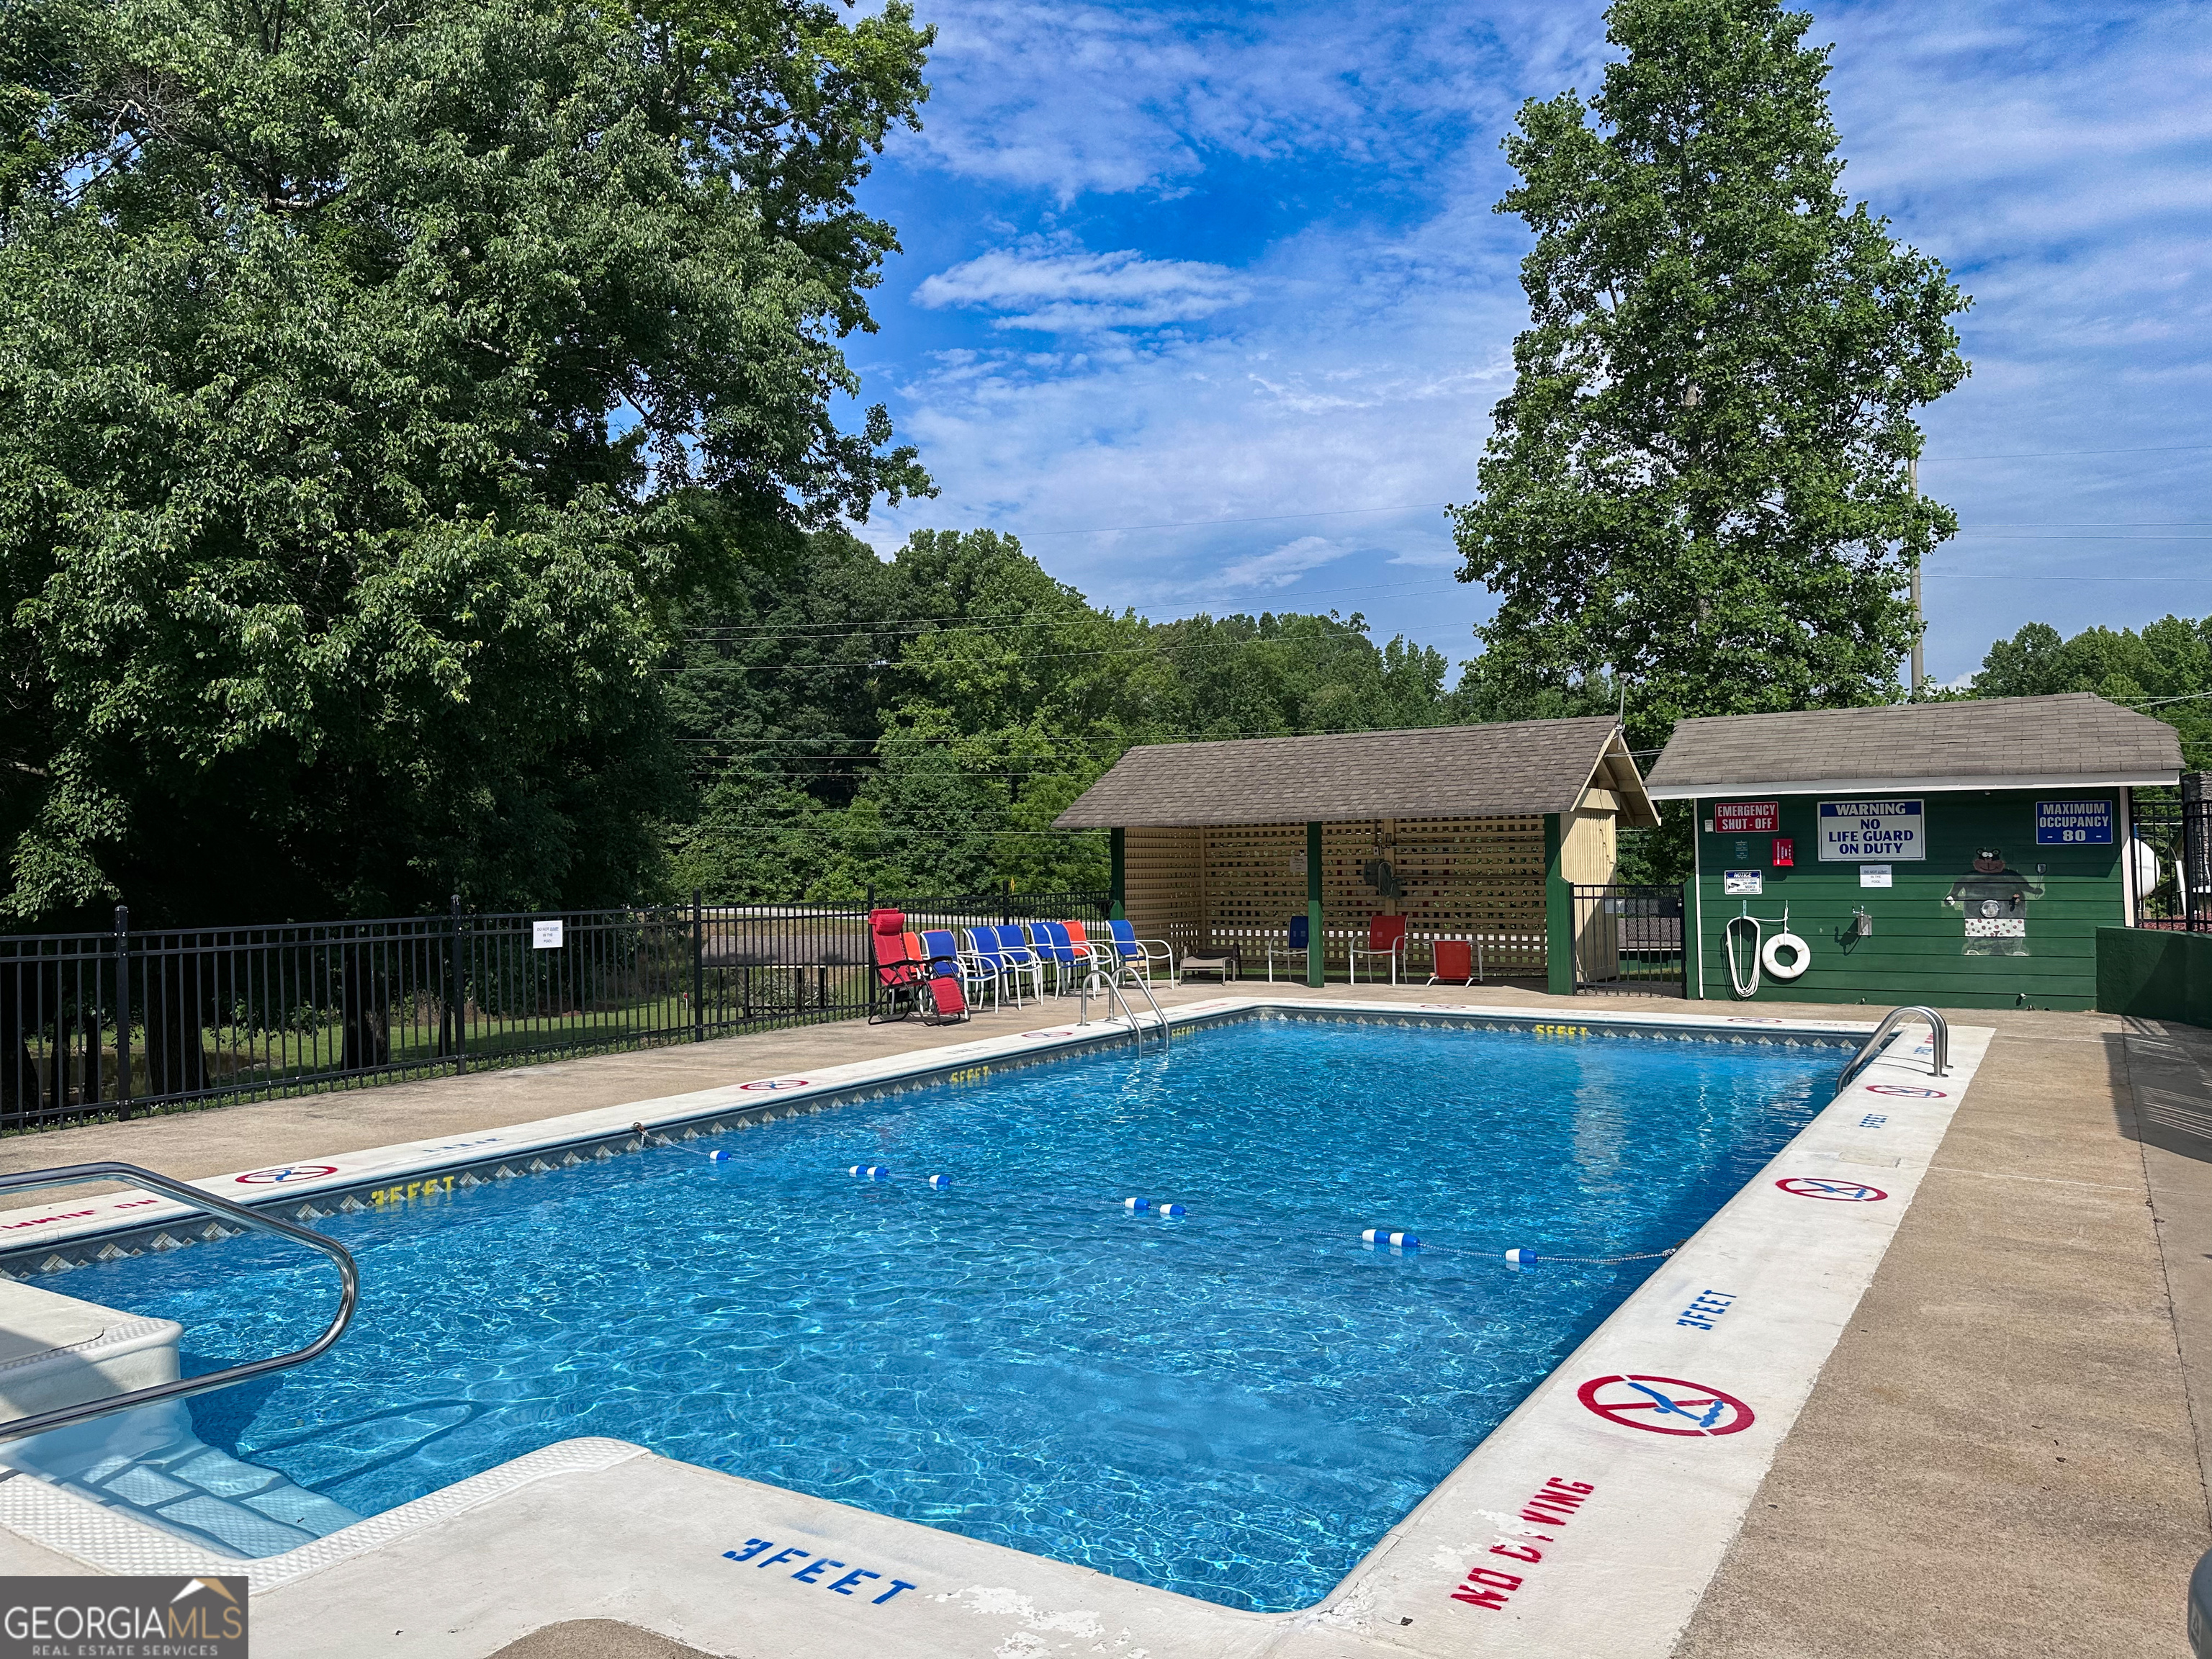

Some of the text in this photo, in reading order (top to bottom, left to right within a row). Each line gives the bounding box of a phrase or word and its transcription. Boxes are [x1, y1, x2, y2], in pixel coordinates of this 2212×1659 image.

[1717, 804, 1776, 817] EMERGENCY
[1835, 803, 1906, 816] WARNING
[2043, 803, 2105, 815] MAXIMUM
[1722, 818, 1748, 830] SHUT
[1755, 817, 1772, 829] OFF
[1860, 819, 1881, 830] NO
[2039, 816, 2109, 827] OCCUPANCY
[1828, 830, 1914, 842] LIFE GUARD
[2062, 830, 2086, 842] 80
[1839, 842, 1903, 855] ON DUTY
[1675, 1289, 1737, 1331] 3FEET
[721, 1537, 918, 1606] 3FEET
[1450, 1567, 1524, 1611] NO
